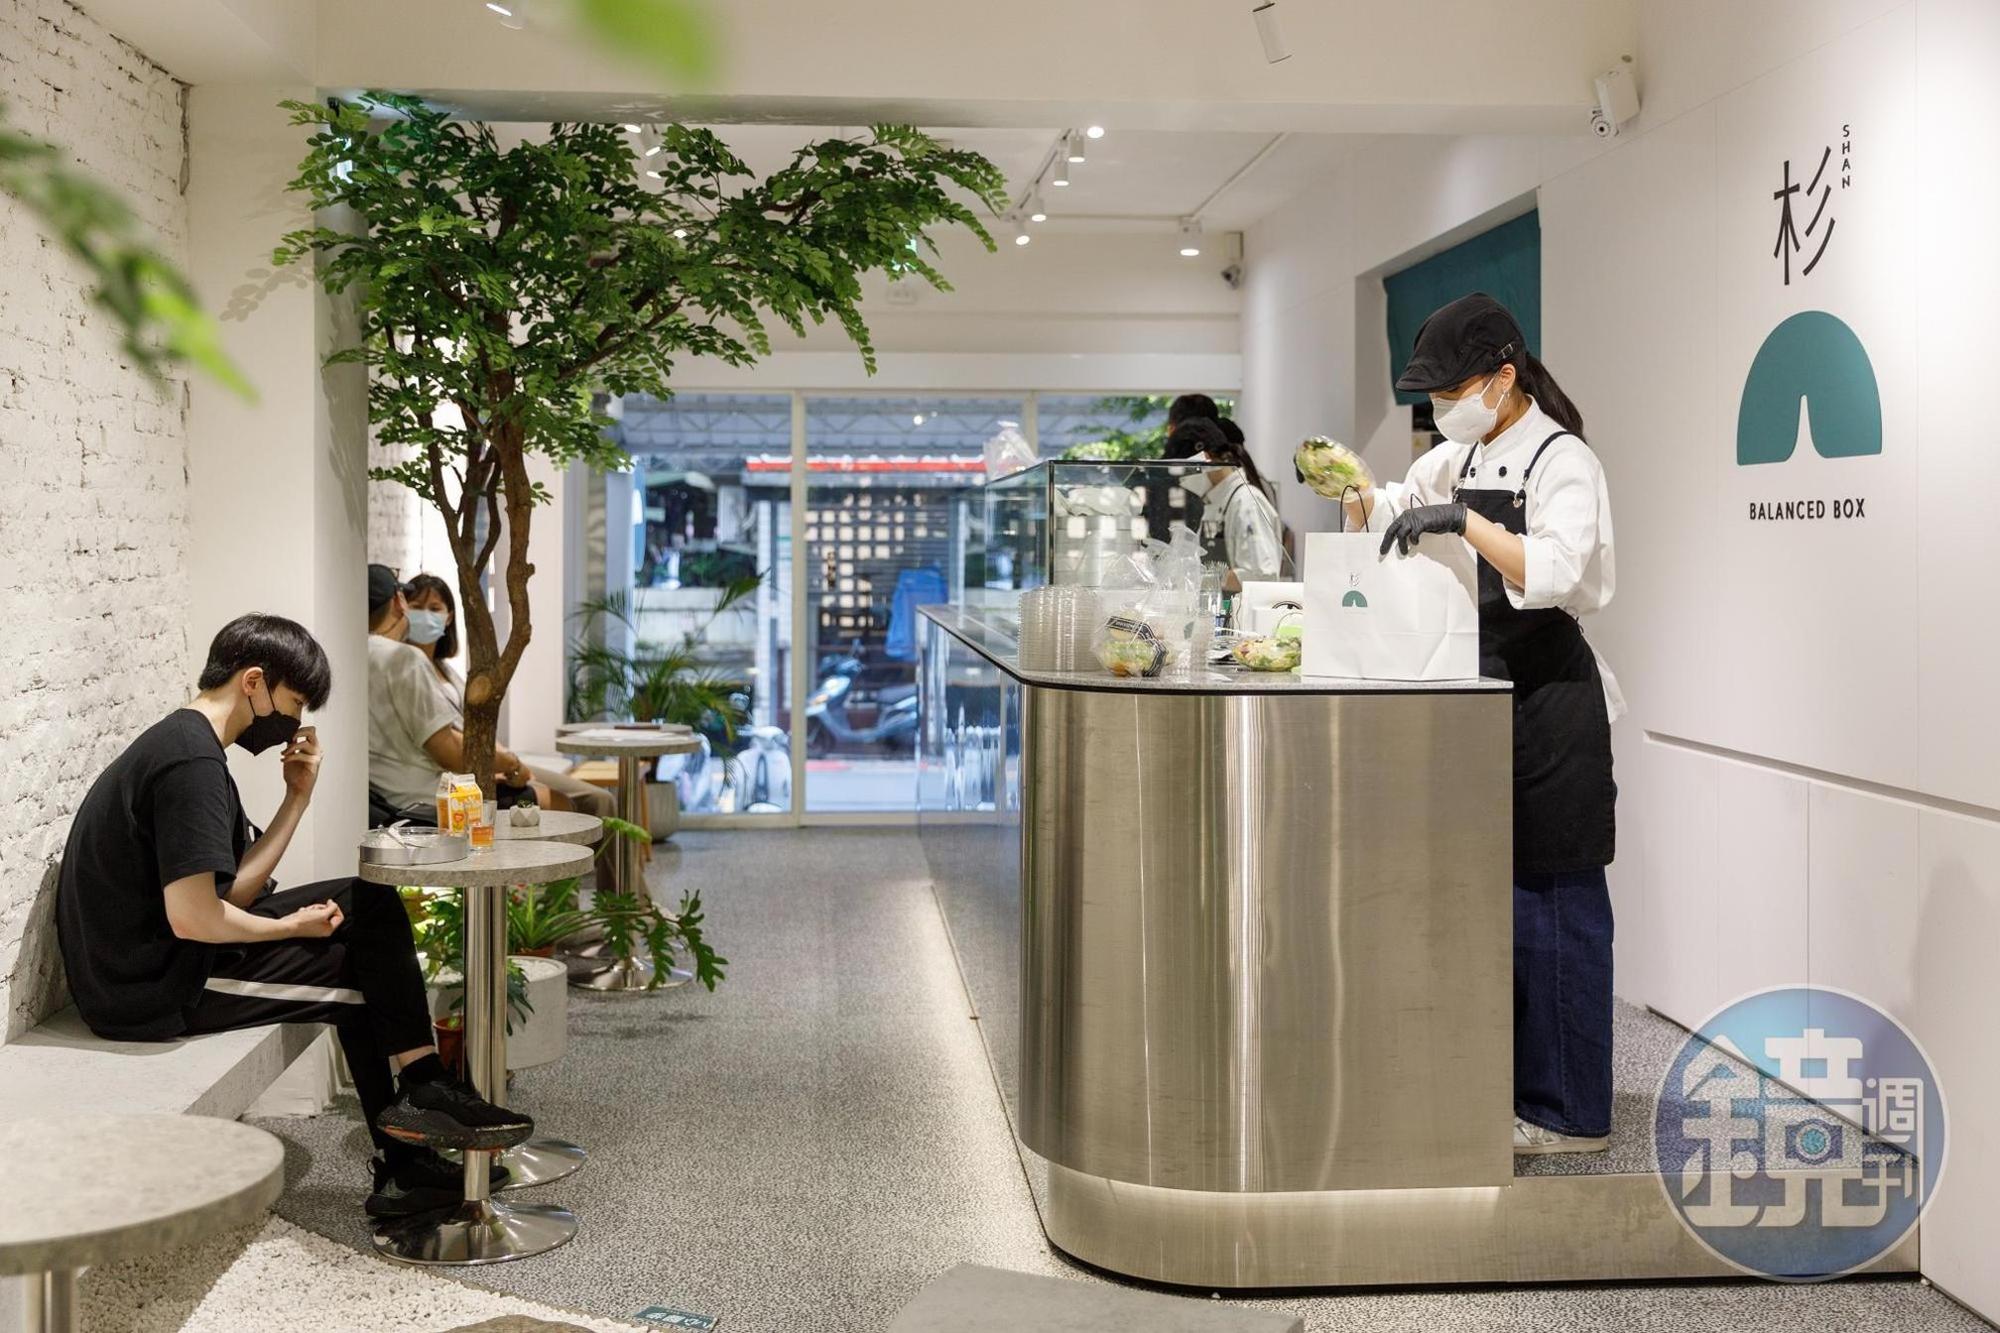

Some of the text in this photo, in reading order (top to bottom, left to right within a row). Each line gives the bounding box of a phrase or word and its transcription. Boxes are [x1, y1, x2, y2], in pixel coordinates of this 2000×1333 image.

[1841, 123, 1851, 189] SHAN
[1773, 145, 1836, 286] 杉
[1749, 498, 1865, 520] BALANCED BOX
